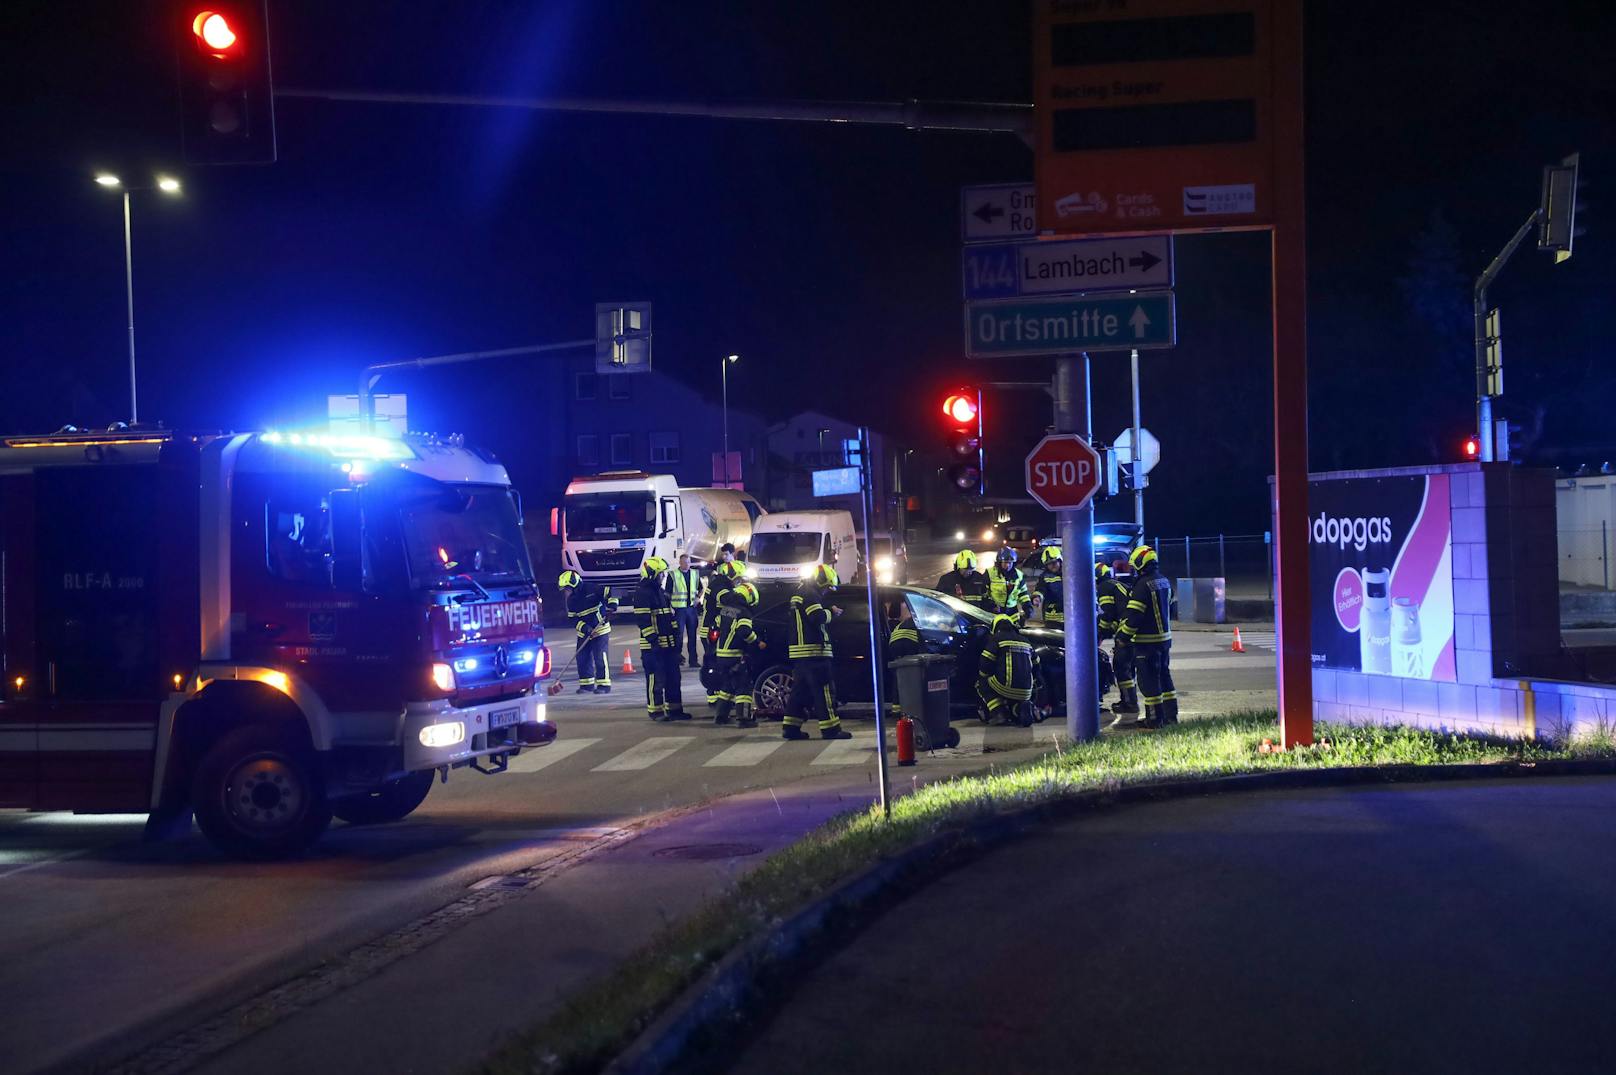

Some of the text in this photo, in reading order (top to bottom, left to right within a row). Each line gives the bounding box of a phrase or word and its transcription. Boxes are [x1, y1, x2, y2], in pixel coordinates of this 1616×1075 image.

[1112, 80, 1165, 97] Super
[1116, 193, 1153, 205] Cards
[1129, 205, 1161, 217] Cash
[968, 251, 1125, 290] 144 Lambach
[978, 307, 1119, 342] Ortsmitte
[1034, 460, 1091, 487] STOP
[1308, 511, 1392, 552] dopgas
[63, 572, 112, 590] RLF-A
[448, 600, 539, 632] FEUERWEHR
